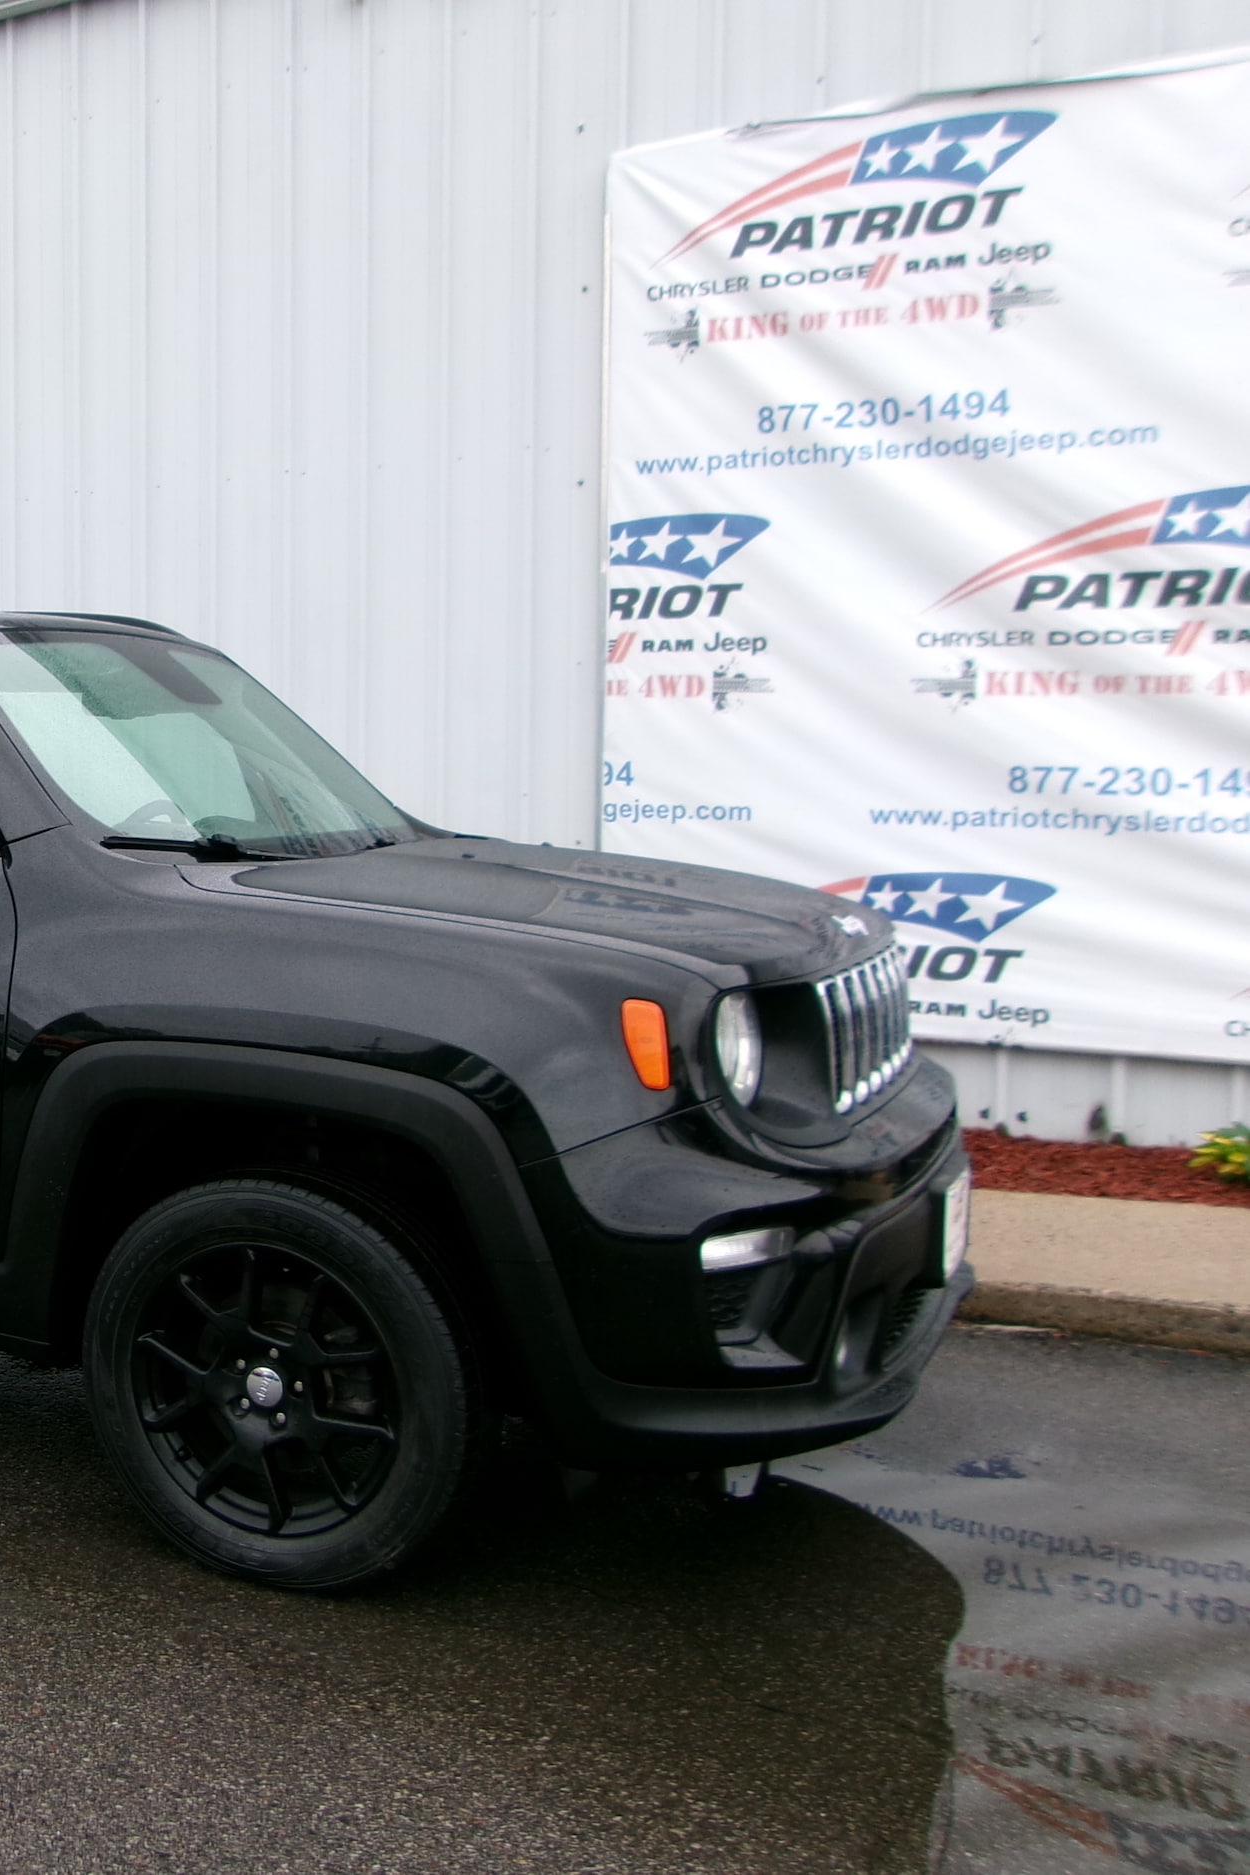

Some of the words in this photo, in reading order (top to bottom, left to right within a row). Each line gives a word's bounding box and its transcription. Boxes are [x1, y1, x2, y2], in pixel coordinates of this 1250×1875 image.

[729, 186, 1024, 259] PATRIOT
[646, 275, 749, 302] CHRYSLER
[760, 264, 874, 289] DODGE
[904, 254, 966, 275] RAM
[977, 240, 1052, 269] Jeep
[706, 311, 789, 343] KING
[800, 311, 830, 333] OF
[838, 303, 888, 328] THE
[901, 293, 981, 325] 4WD
[757, 387, 1012, 435] 877-230-1494
[635, 422, 1160, 476] www.patriotchryslerdodgejeep.com
[641, 638, 694, 653] RAM
[704, 631, 768, 656] Jeep
[916, 630, 1036, 648] CHRYSLER
[1048, 629, 1179, 646] DODGE
[639, 674, 706, 698] 4WD
[985, 670, 1081, 696] KING
[1092, 675, 1125, 694] OF
[1134, 674, 1193, 694] THE
[1008, 765, 1250, 796] 877-230-14
[898, 945, 1026, 983] IOT
[909, 1000, 967, 1017] RAM
[978, 999, 1051, 1027] Jeep
